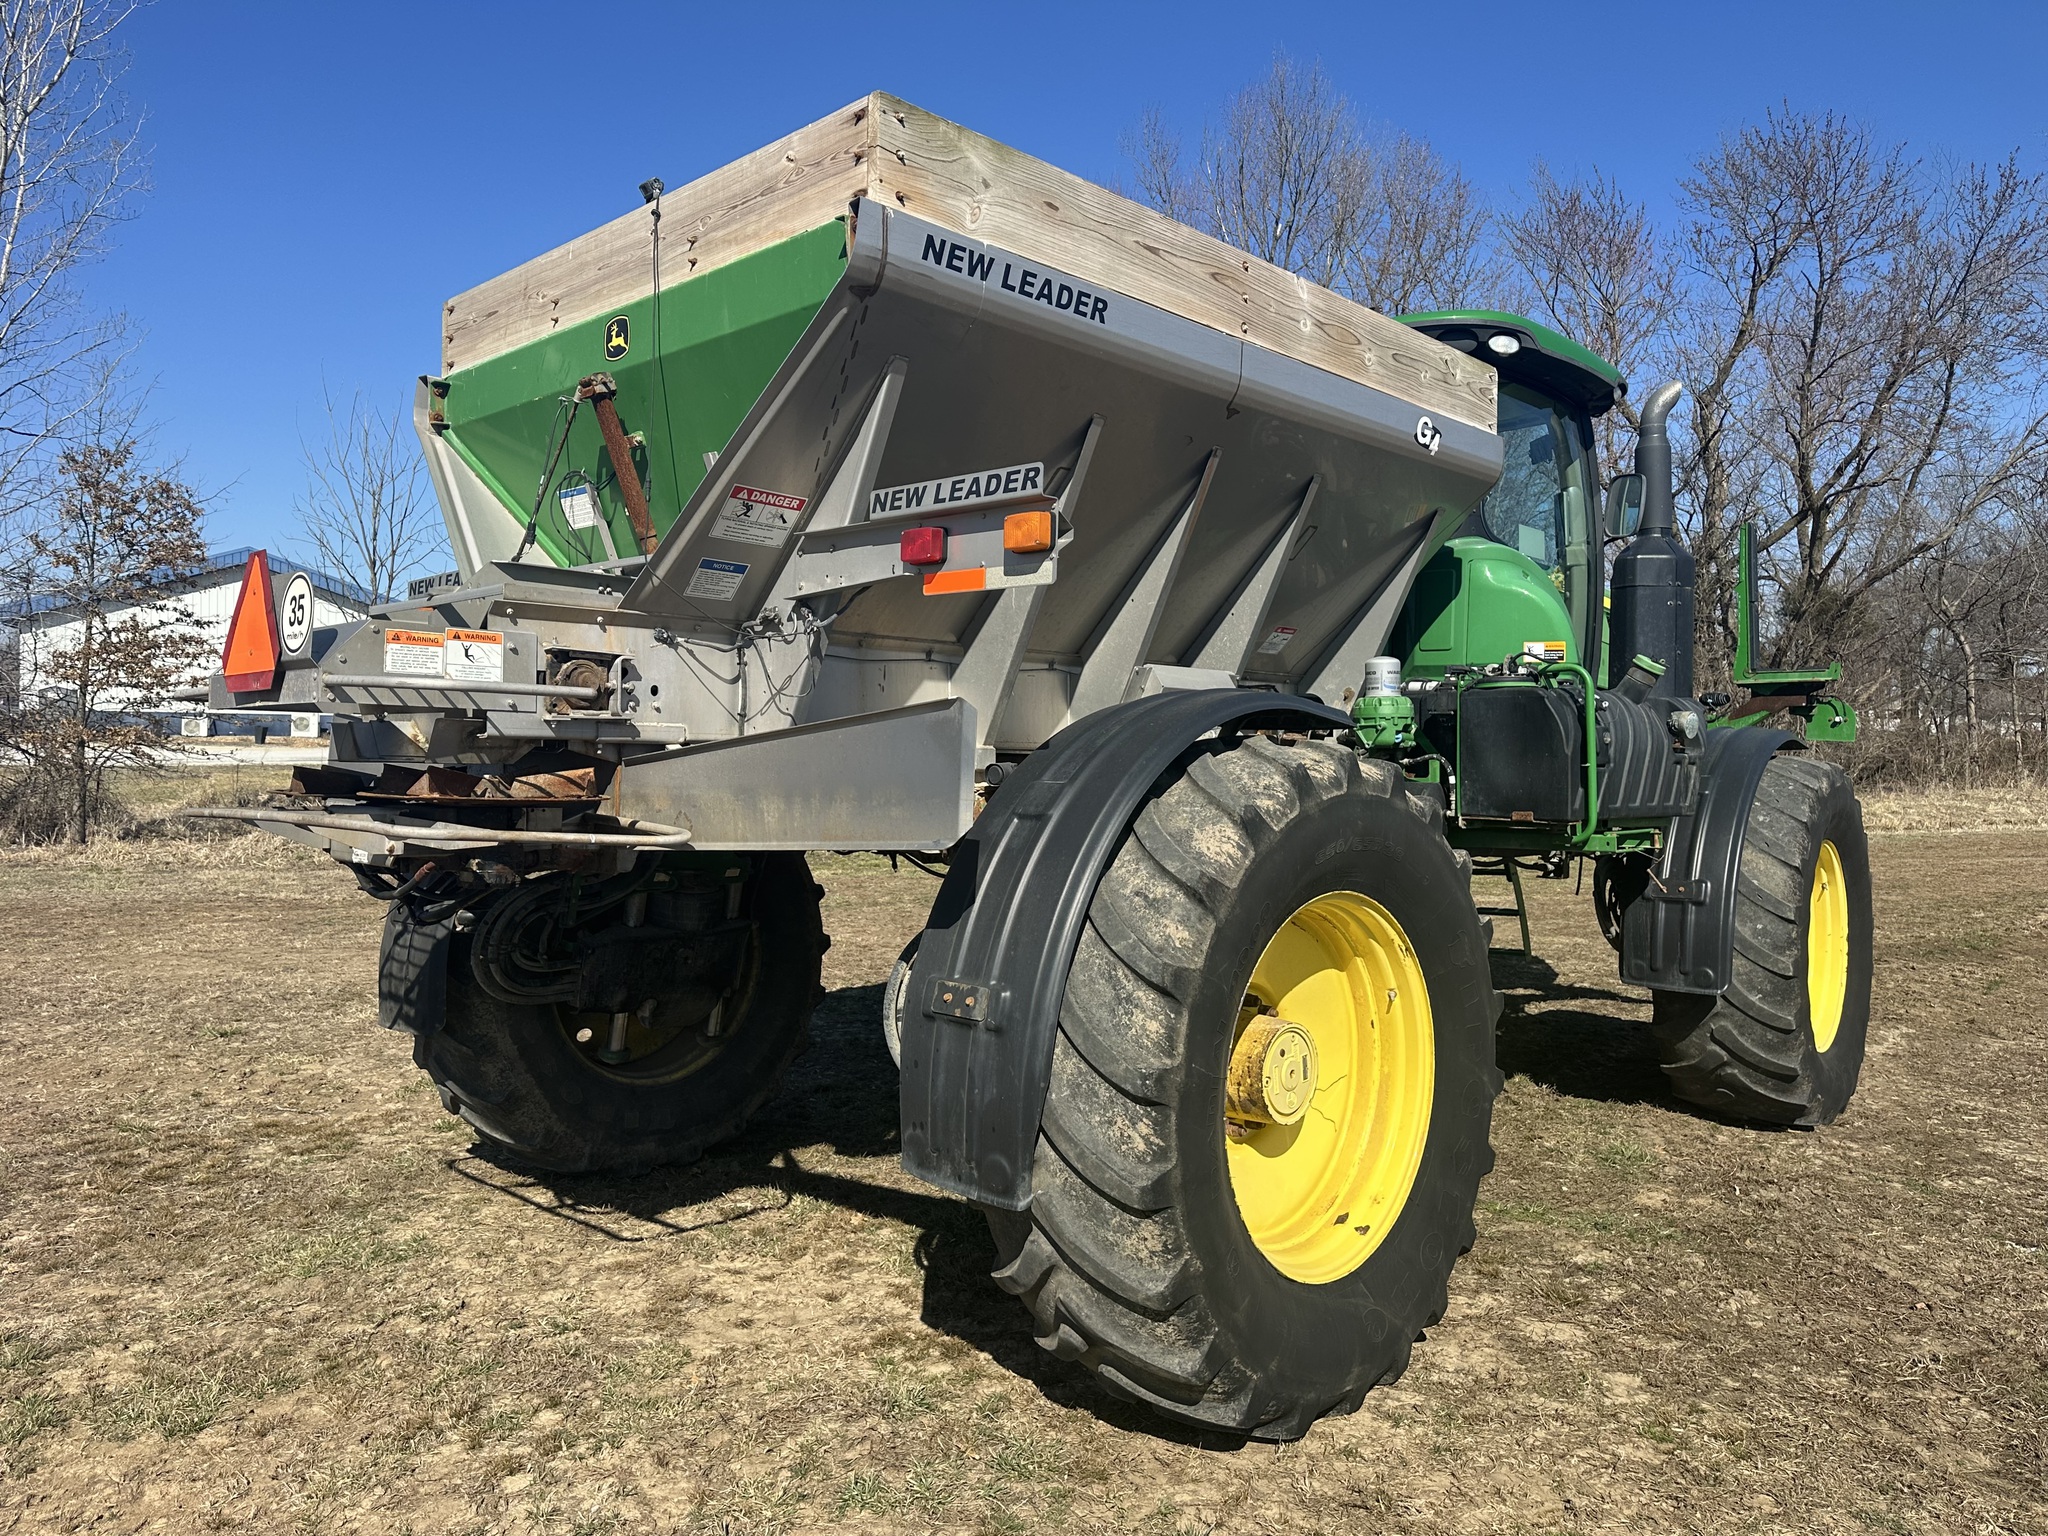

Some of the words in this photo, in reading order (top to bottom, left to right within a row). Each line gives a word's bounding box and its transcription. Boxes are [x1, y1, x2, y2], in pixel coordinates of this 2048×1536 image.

[922, 234, 995, 282] NEW
[1001, 263, 1108, 324] LEADER
[1416, 416, 1441, 456] G4
[872, 485, 928, 514] NEW
[933, 466, 1041, 505] LEADER
[750, 491, 800, 509] DANGER
[712, 563, 735, 571] NOTICE
[409, 578, 435, 597] NEW
[289, 594, 305, 627] 35
[287, 631, 304, 640] mile/h
[405, 636, 439, 644] WARNING
[464, 633, 497, 642] WARNING
